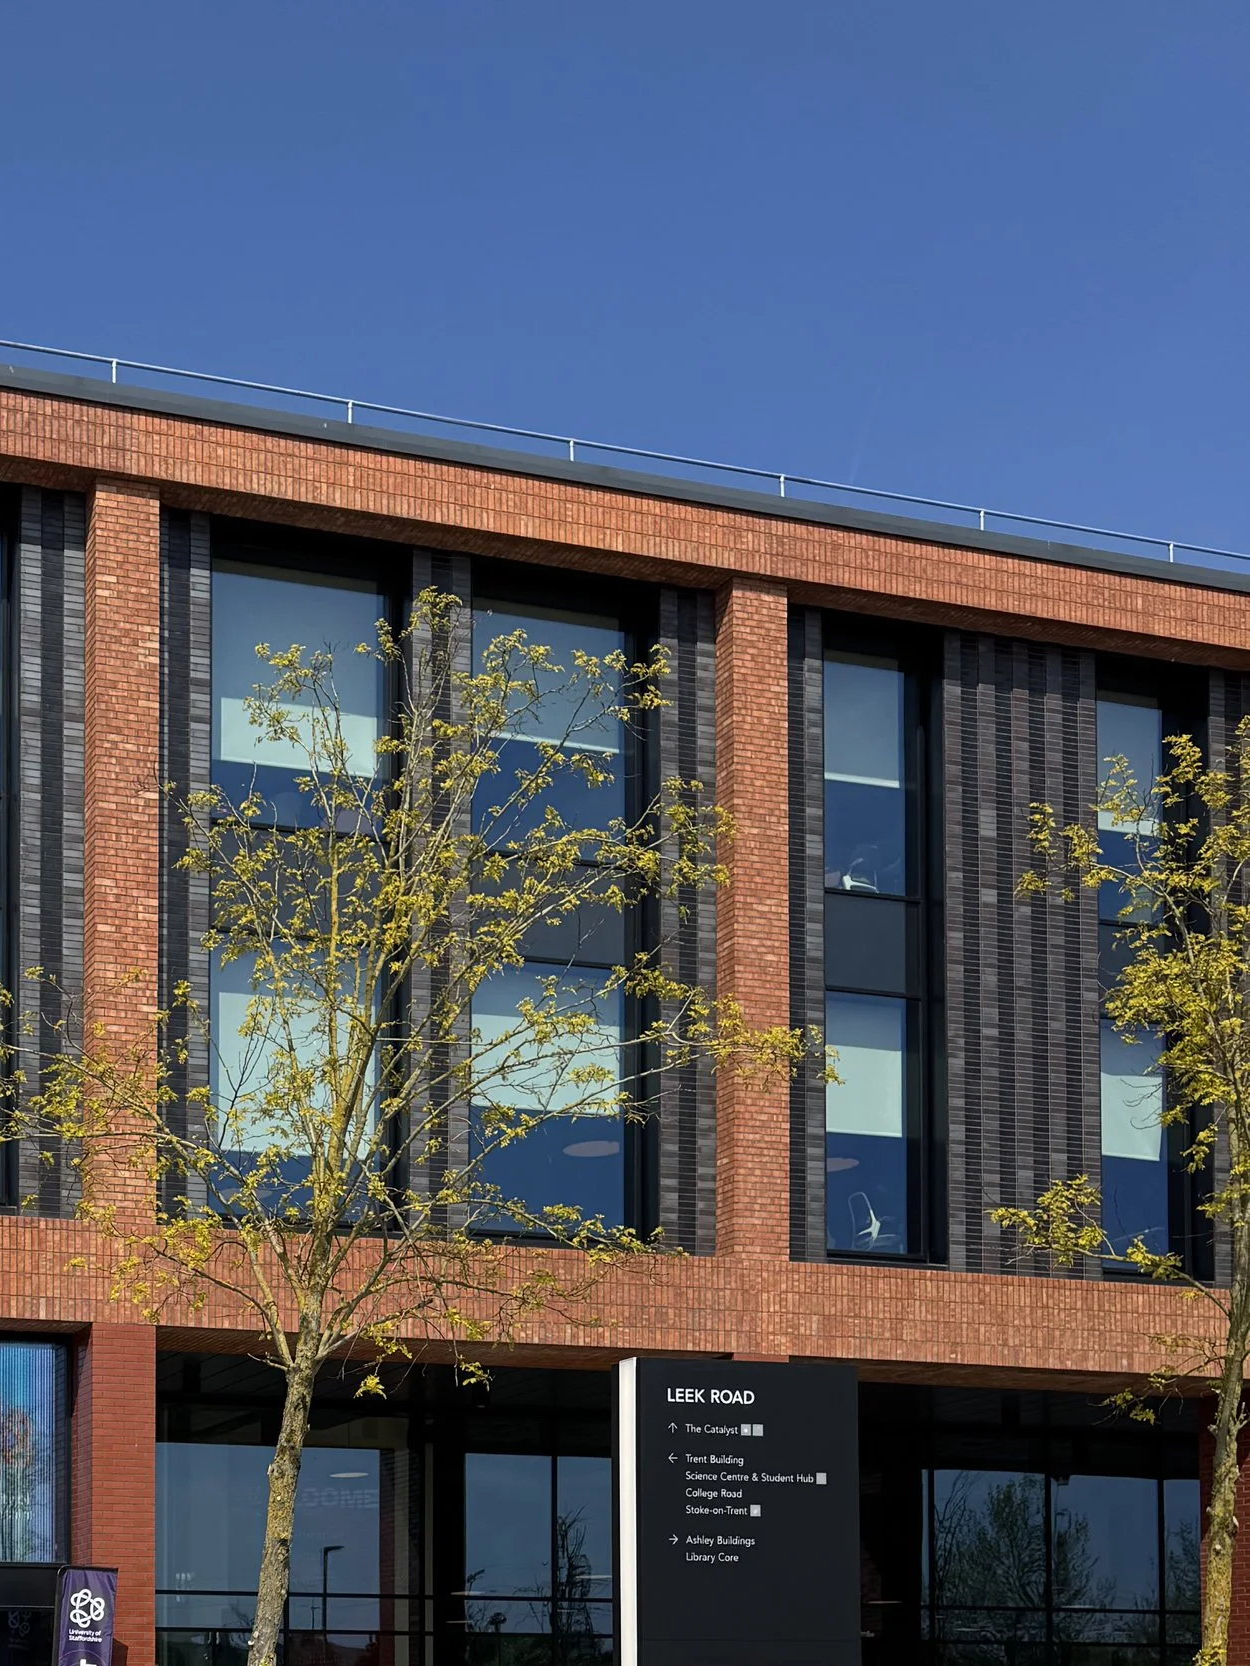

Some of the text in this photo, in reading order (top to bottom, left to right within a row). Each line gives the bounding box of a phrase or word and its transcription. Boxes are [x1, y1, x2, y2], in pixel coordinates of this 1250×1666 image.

[667, 1388, 755, 1404] LEEK ROAD
[685, 1424, 739, 1436] The Catalyst
[685, 1454, 744, 1466] Trent Building
[685, 1471, 815, 1483] Science Centre & Student Hub
[685, 1488, 743, 1500] College Road
[685, 1505, 748, 1515] Stoke-on-Trent
[685, 1535, 756, 1548] Ashley Buildings
[685, 1552, 739, 1563] Library Core
